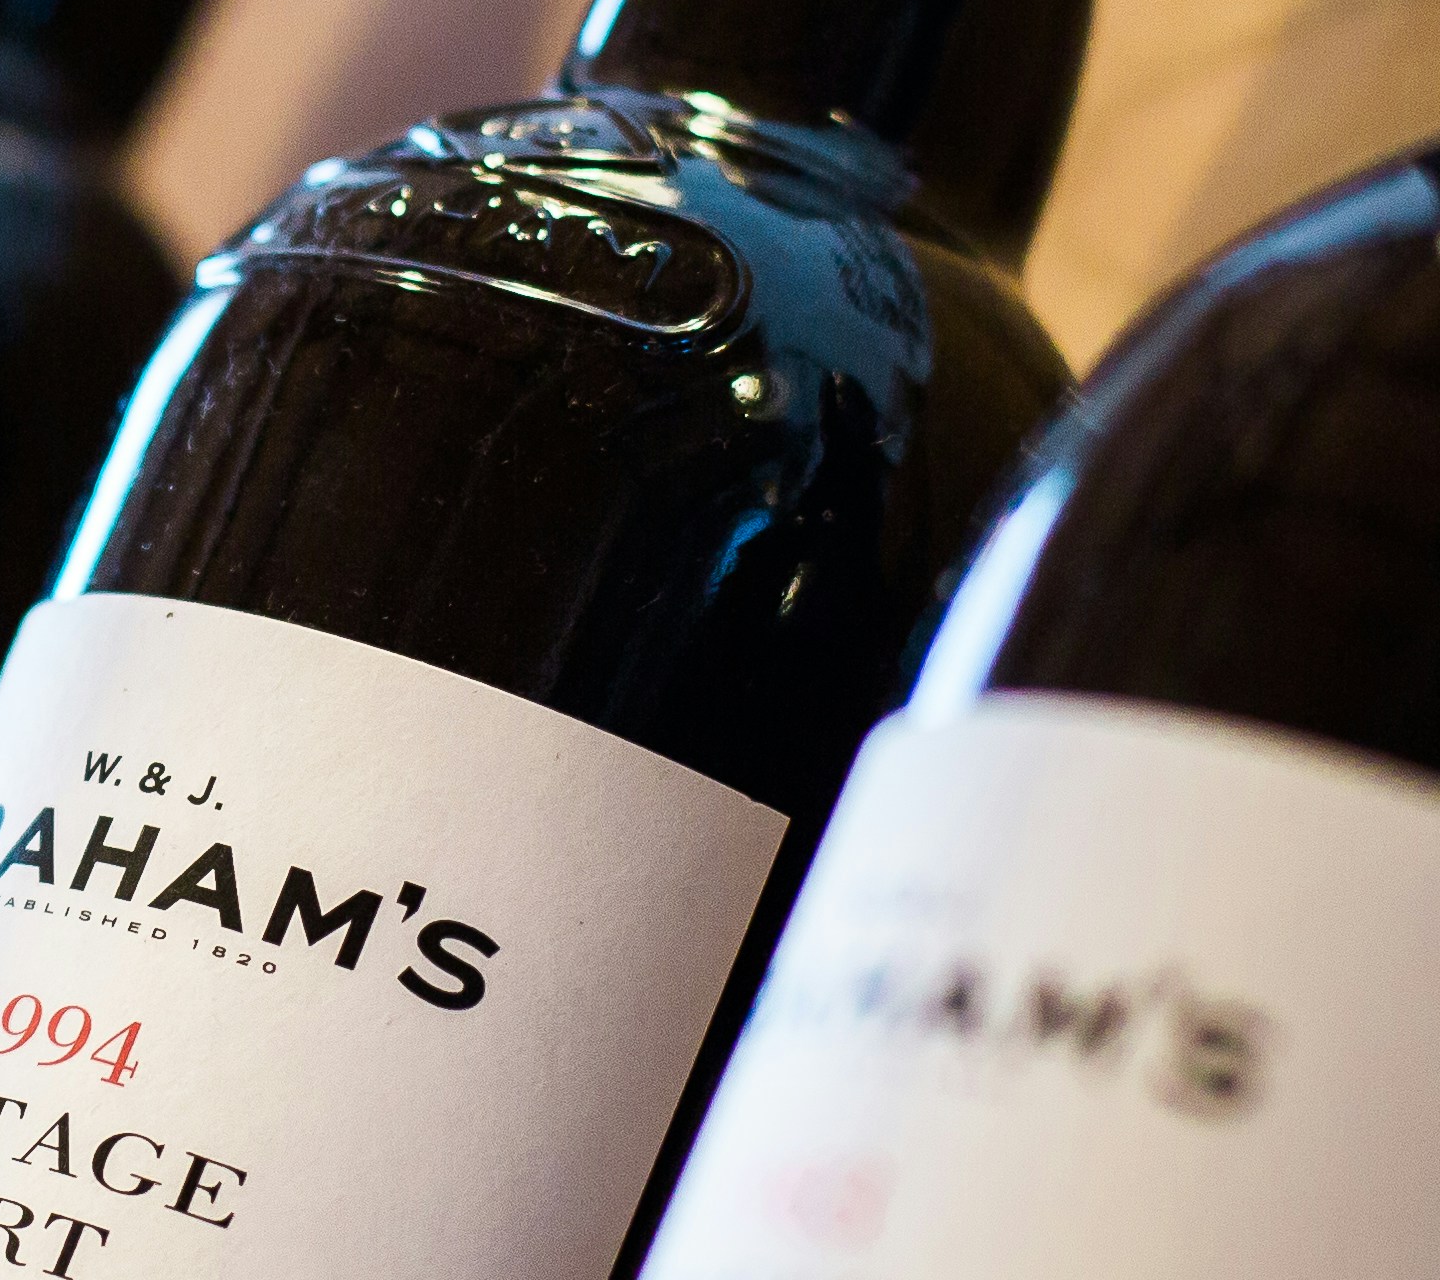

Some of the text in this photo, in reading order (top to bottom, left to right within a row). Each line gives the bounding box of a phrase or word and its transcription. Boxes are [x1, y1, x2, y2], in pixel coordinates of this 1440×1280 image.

[82, 749, 224, 811] W. & J.
[191, 937, 278, 975] 1820
